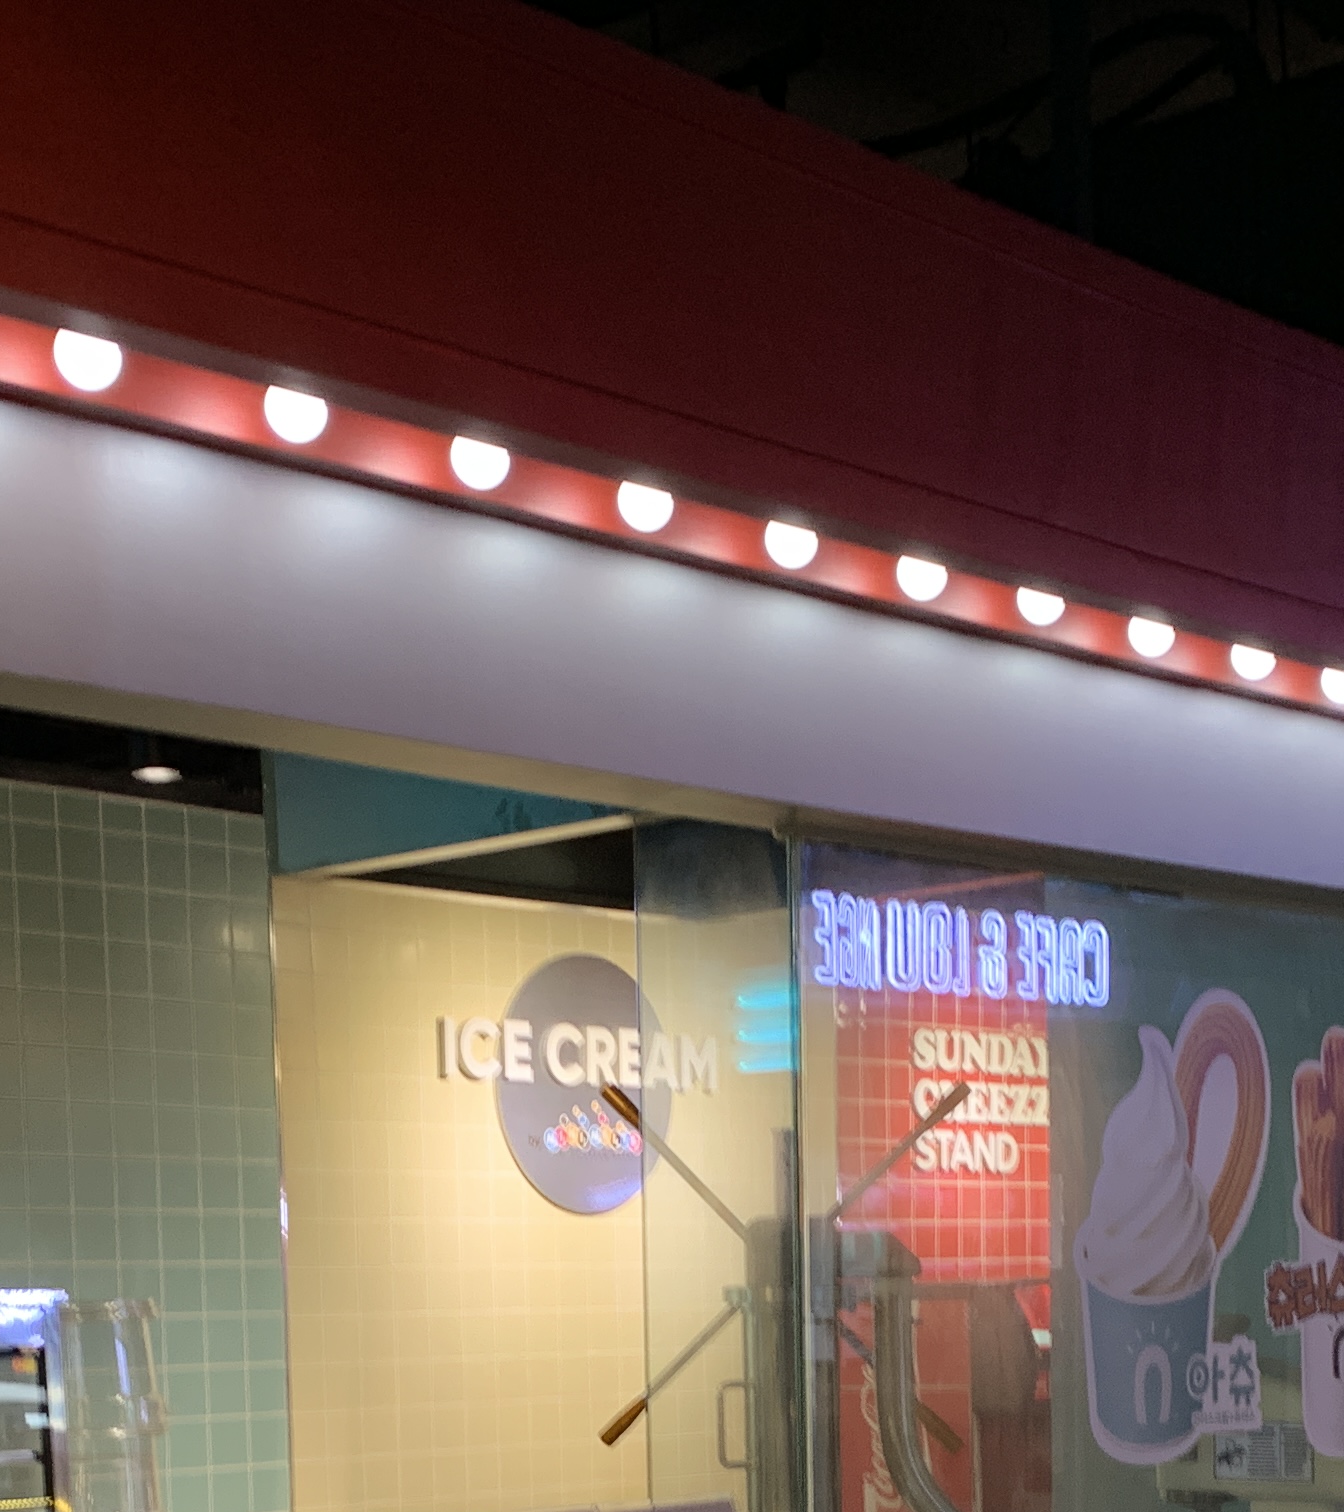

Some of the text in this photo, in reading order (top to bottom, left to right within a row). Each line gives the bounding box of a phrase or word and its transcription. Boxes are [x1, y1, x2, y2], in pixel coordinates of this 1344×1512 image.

[437, 1015, 719, 1096] ICE CREAM
[912, 1027, 1050, 1079] SUNDAY
[913, 1129, 1020, 1175] STAND
[1188, 1345, 1255, 1407] 아츄
